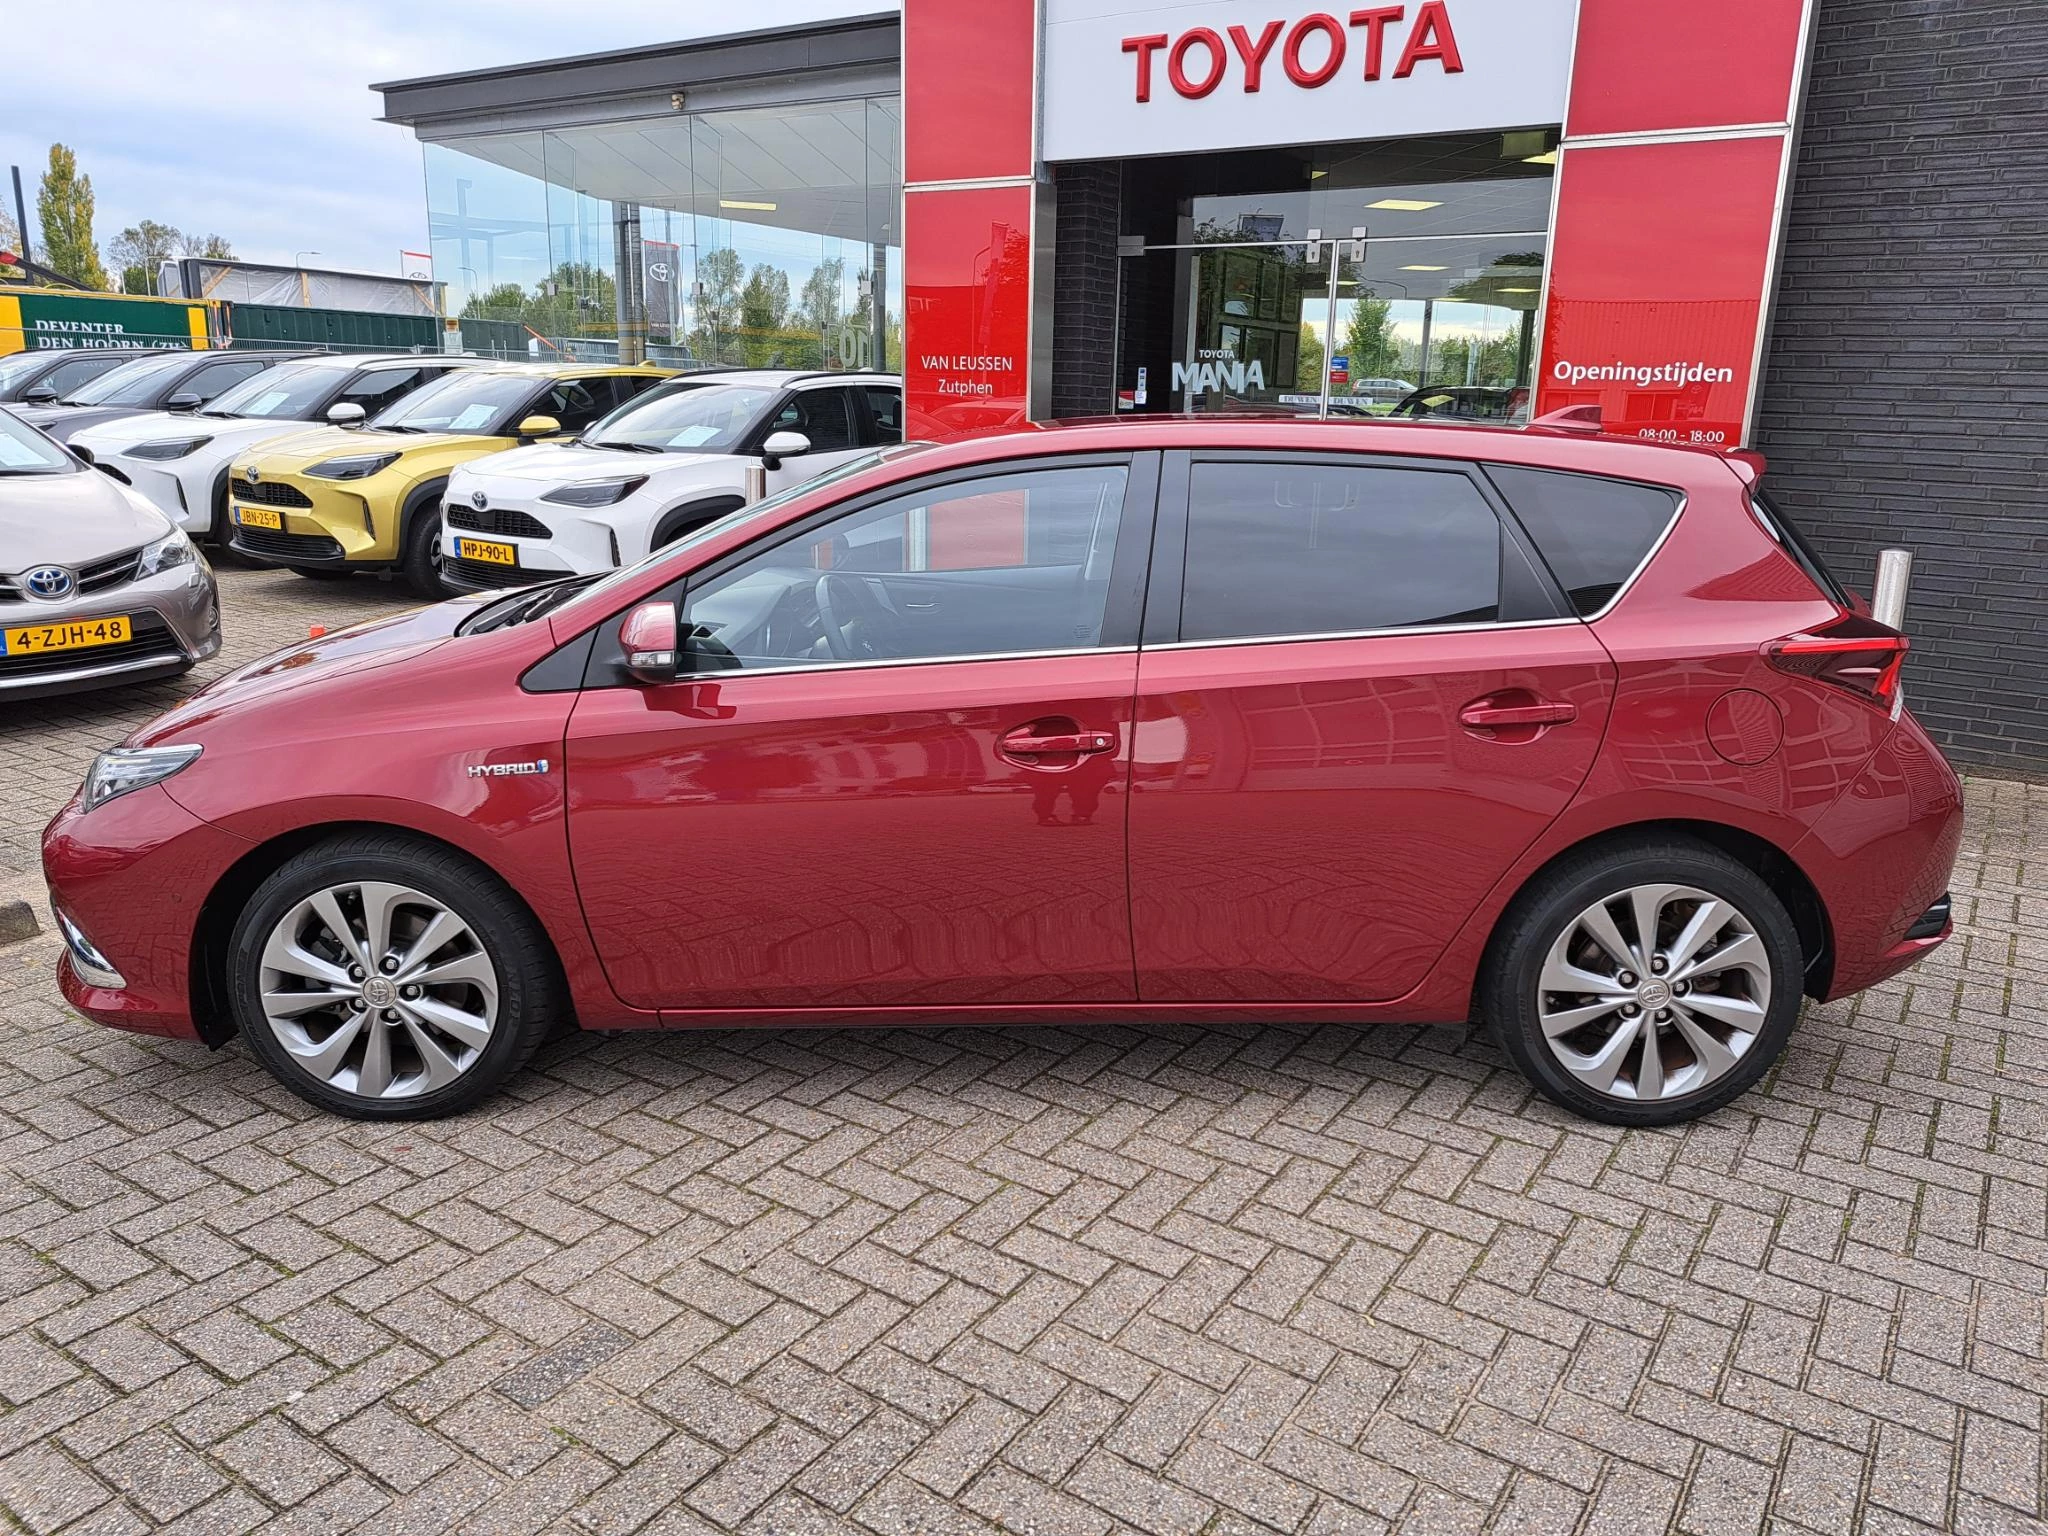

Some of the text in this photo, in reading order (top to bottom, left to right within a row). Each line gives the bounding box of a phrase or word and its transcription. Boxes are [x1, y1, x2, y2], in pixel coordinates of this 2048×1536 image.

[1121, 0, 1464, 104] TOYOTA
[35, 319, 124, 334] DEVENTER
[38, 336, 76, 349] DEN
[83, 339, 144, 349] HOORN
[1199, 350, 1235, 359] TOYOTA
[921, 355, 1013, 371] VAN LEUSSEN
[1171, 360, 1266, 394] MANIA
[1553, 360, 1733, 387] Openingstijden
[938, 378, 993, 397] Zutphen
[1639, 428, 1677, 440] 08:00
[1690, 430, 1725, 443] 18:00
[242, 510, 277, 526] JBN-25-P
[463, 541, 510, 562] HPJ-90-L
[17, 621, 122, 649] 4-ZJH-48
[467, 762, 536, 777] HYBRID
